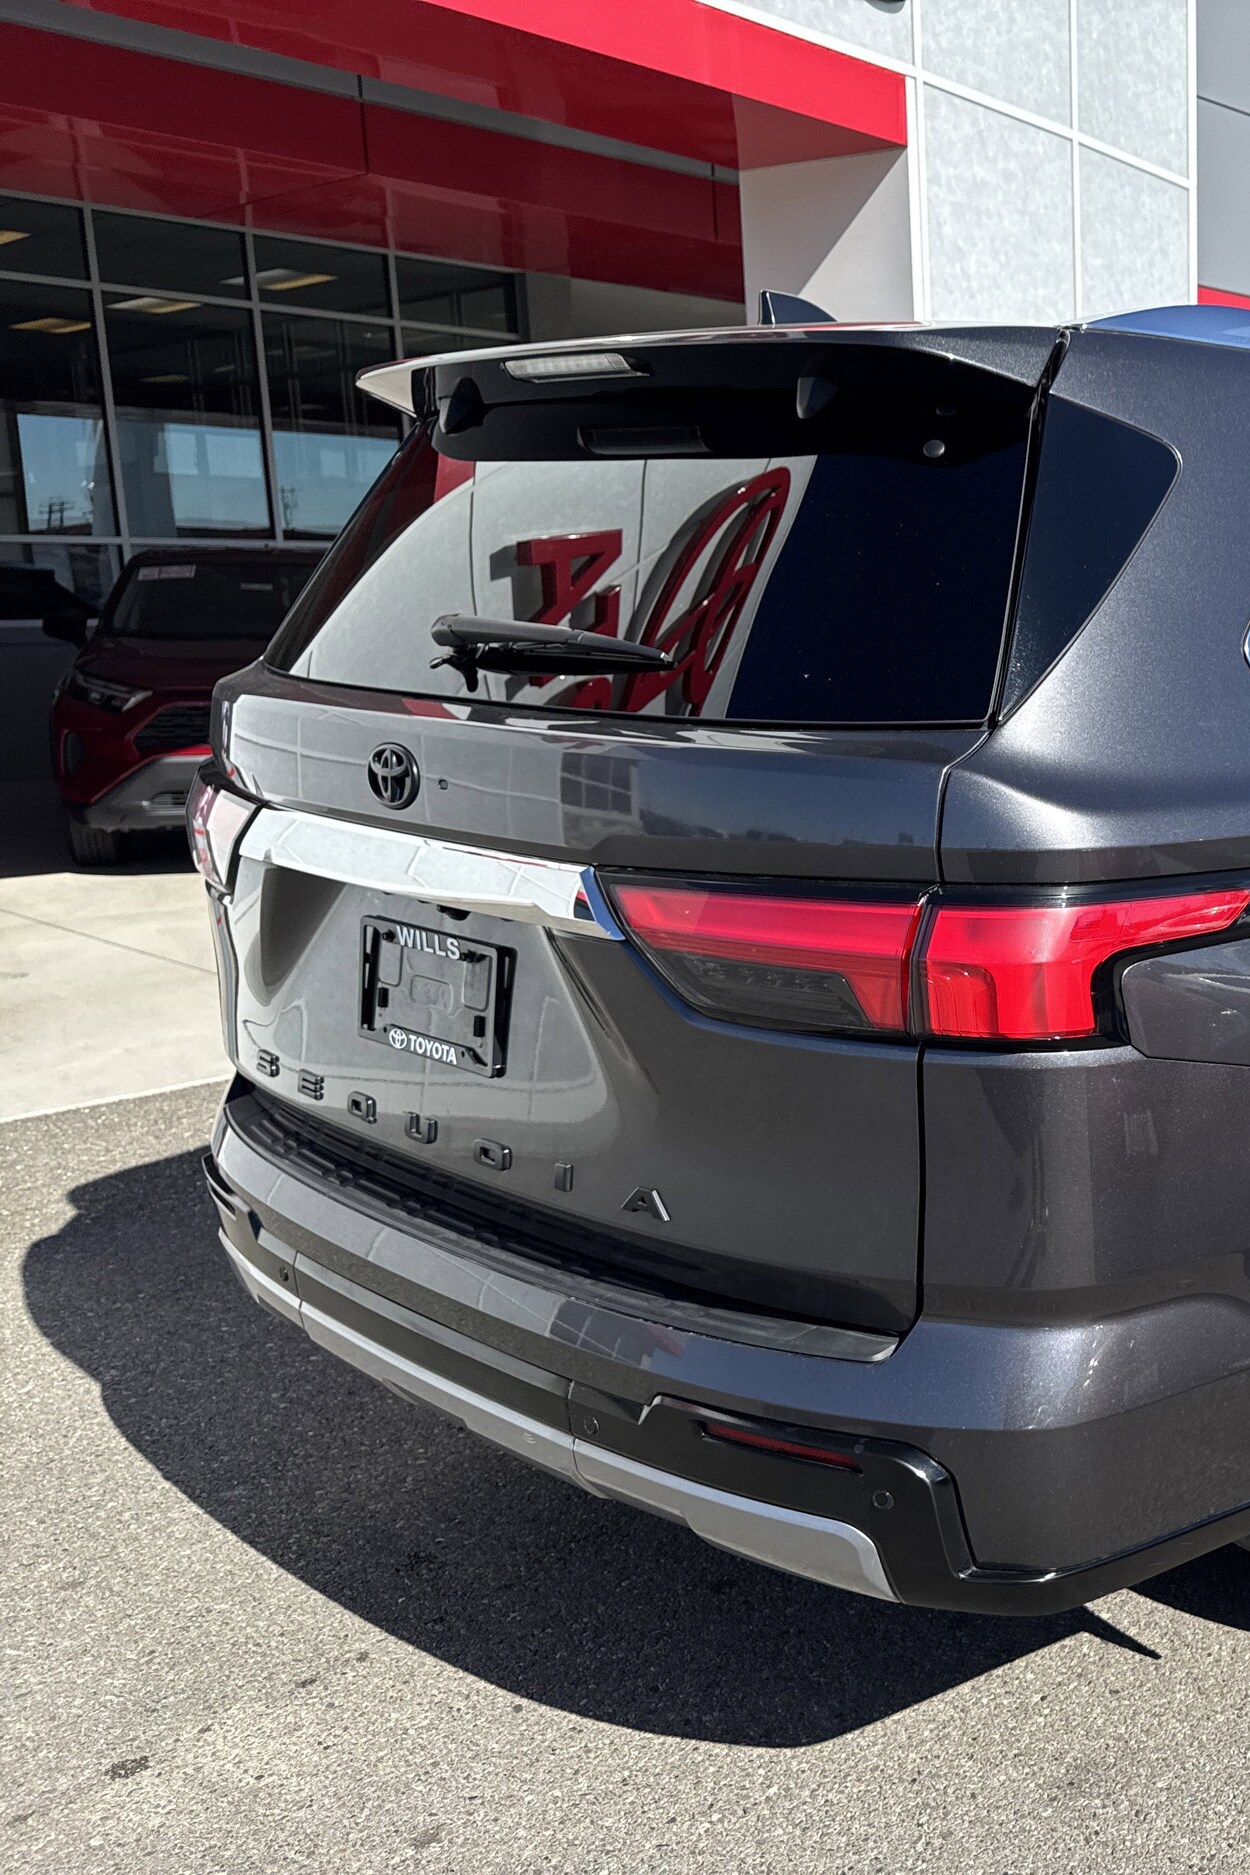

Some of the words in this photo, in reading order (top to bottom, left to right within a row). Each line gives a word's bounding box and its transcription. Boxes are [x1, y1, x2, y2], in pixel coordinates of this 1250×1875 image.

[396, 925, 461, 960] WILLS
[409, 1034, 457, 1065] TOYOTA
[256, 1048, 671, 1222] SEQUOIA
